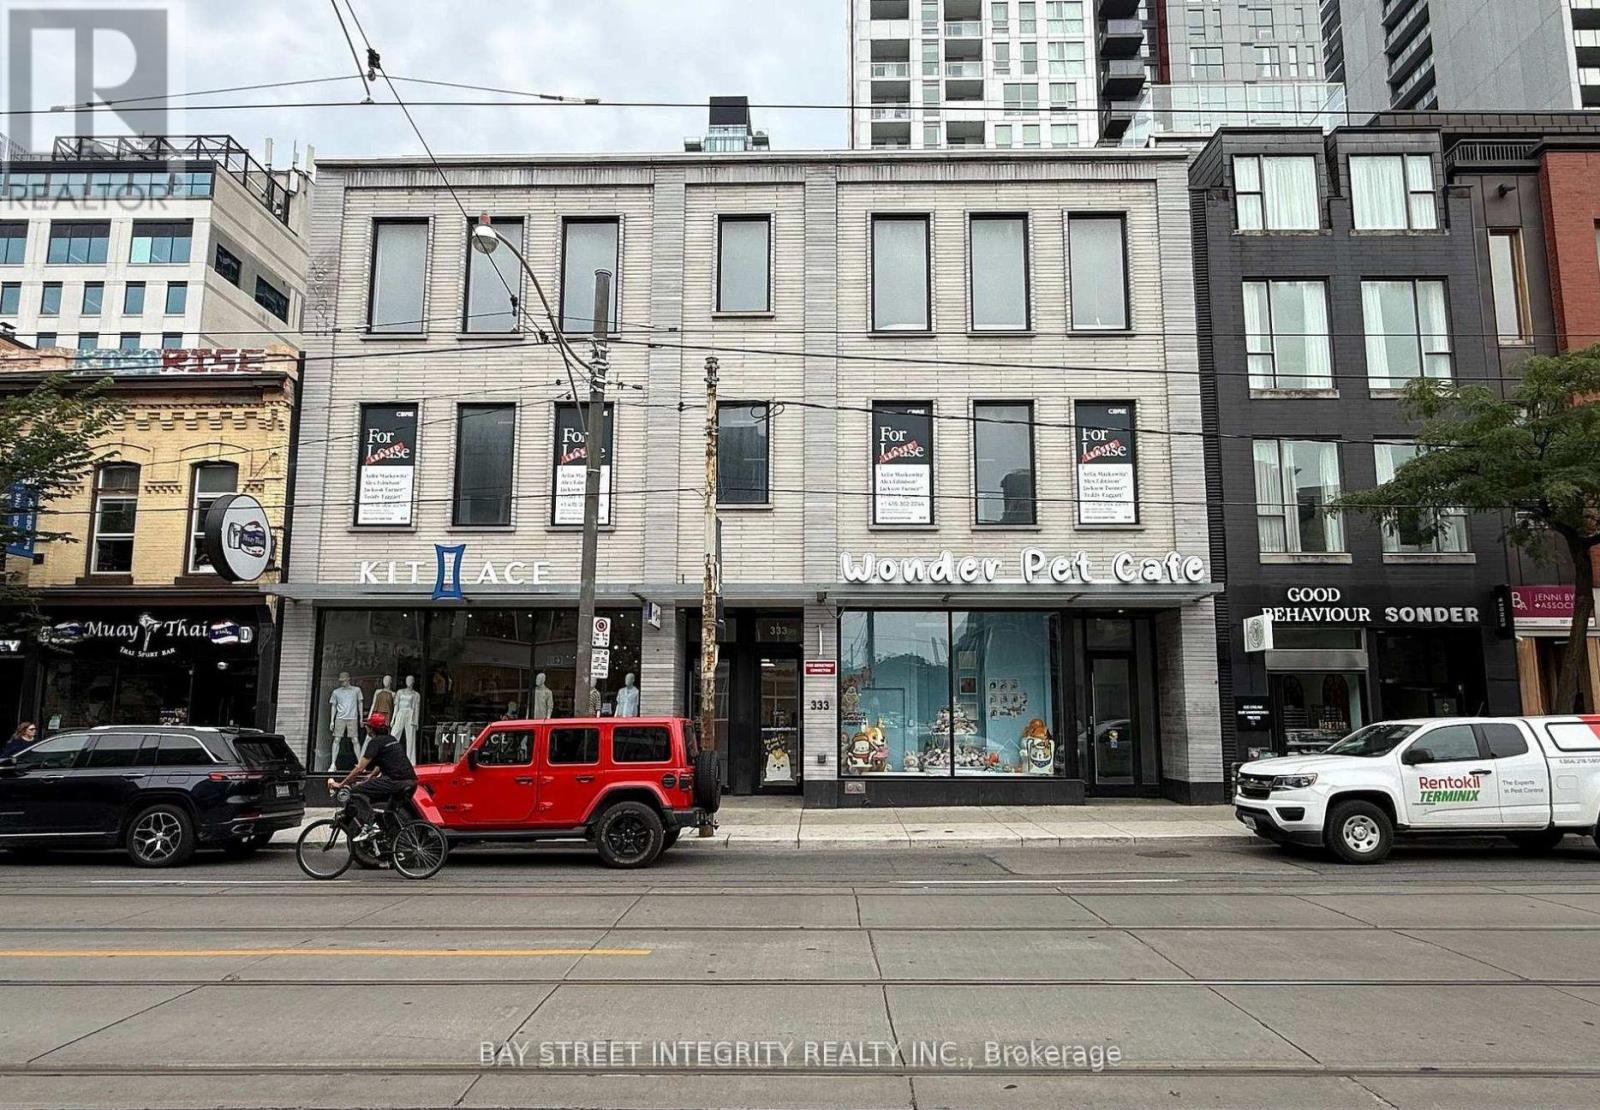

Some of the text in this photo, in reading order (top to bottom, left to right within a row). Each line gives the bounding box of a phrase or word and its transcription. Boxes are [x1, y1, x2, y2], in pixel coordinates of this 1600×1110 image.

[367, 428, 394, 443] For
[562, 427, 589, 443] For
[880, 426, 907, 441] For
[1082, 427, 1108, 440] For
[359, 560, 551, 585] KIT ACE
[840, 547, 1205, 584] Wonder Pet Cafe
[1287, 587, 1341, 602] GOOD
[1534, 593, 1561, 602] JENNI
[1262, 606, 1372, 622] BEHAVIOUR
[1385, 606, 1479, 623] SONDER
[84, 620, 139, 643] Muay
[164, 619, 209, 637] Thai
[769, 626, 788, 636] 333
[810, 700, 830, 710] 333
[441, 733, 467, 744] KIT
[1419, 776, 1480, 789] Rentokil
[1420, 790, 1480, 803] TERMINIX
